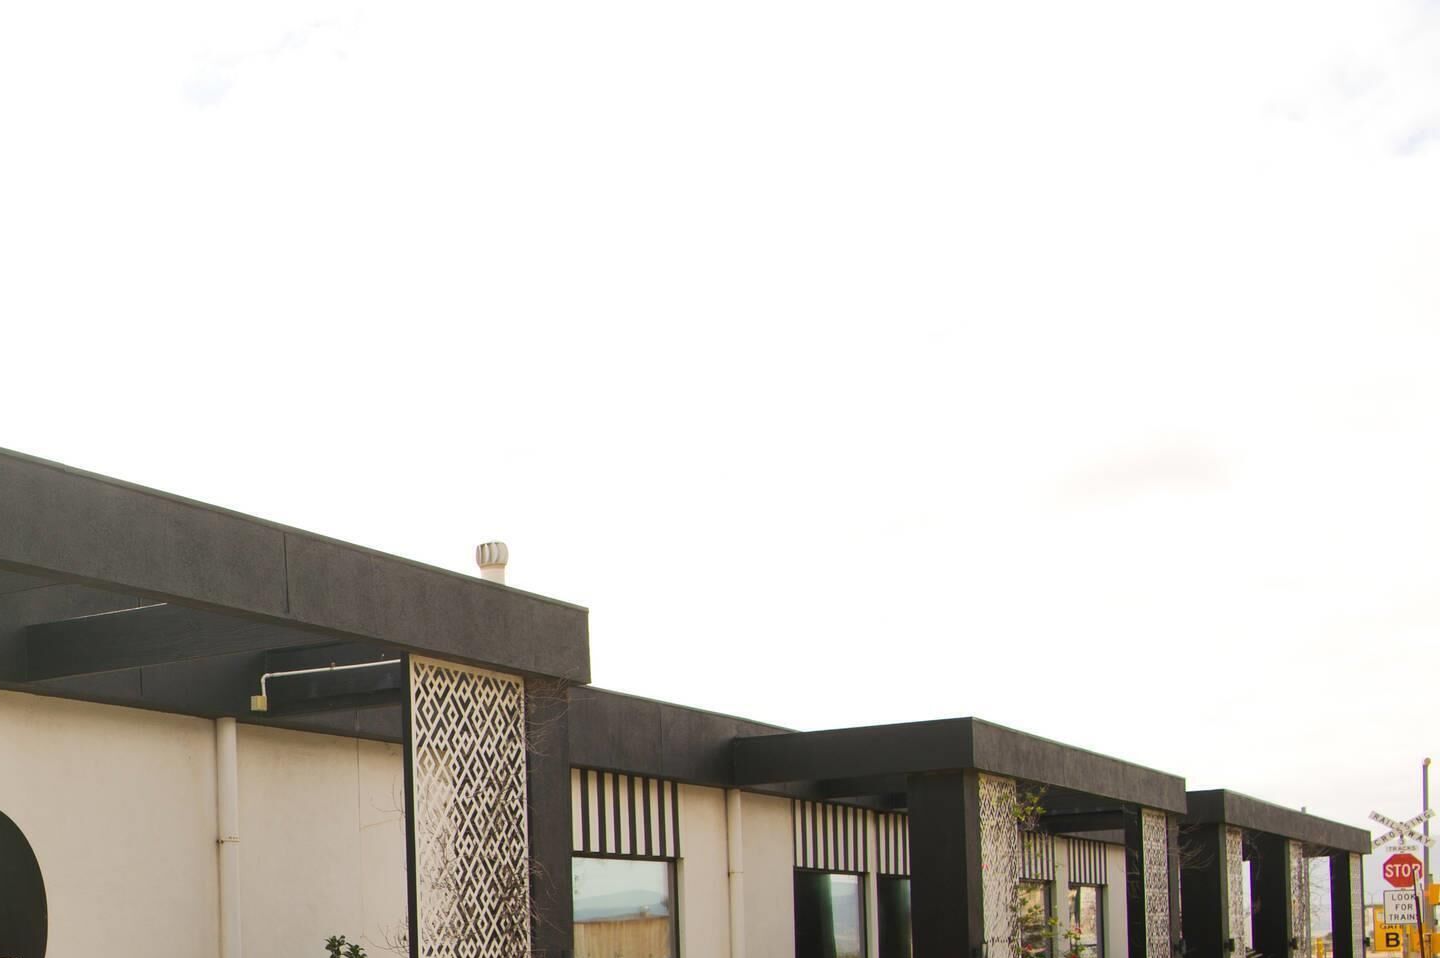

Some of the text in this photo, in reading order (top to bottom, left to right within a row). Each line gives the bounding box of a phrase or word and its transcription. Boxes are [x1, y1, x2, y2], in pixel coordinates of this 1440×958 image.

[1384, 863, 1421, 878] STOP
[1391, 893, 1416, 901] LOOK
[1394, 903, 1413, 911] FOR
[1389, 913, 1416, 921] TRAIN
[1385, 932, 1400, 948] B
